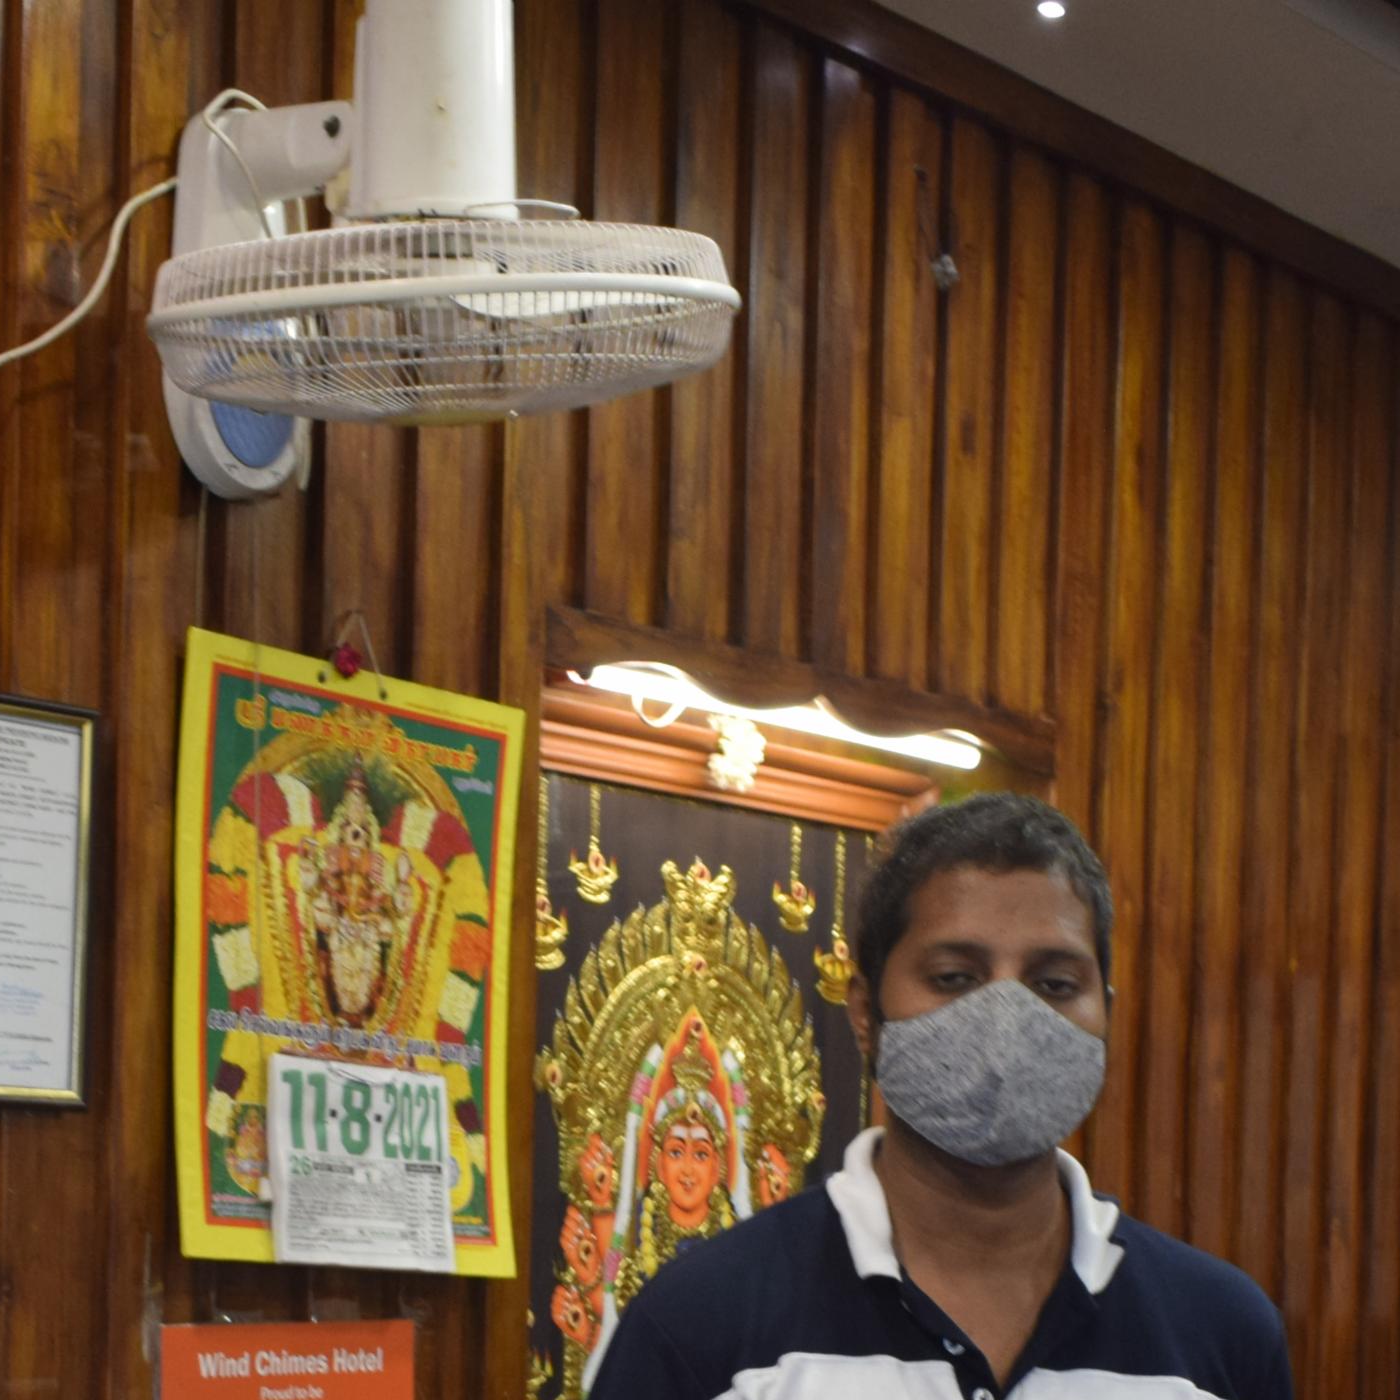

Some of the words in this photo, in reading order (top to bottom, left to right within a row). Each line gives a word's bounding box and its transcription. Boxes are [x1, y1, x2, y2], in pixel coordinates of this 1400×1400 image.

[198, 1352, 250, 1379] Wind
[254, 1350, 330, 1377] Chimes
[332, 1347, 384, 1373] Hotel
